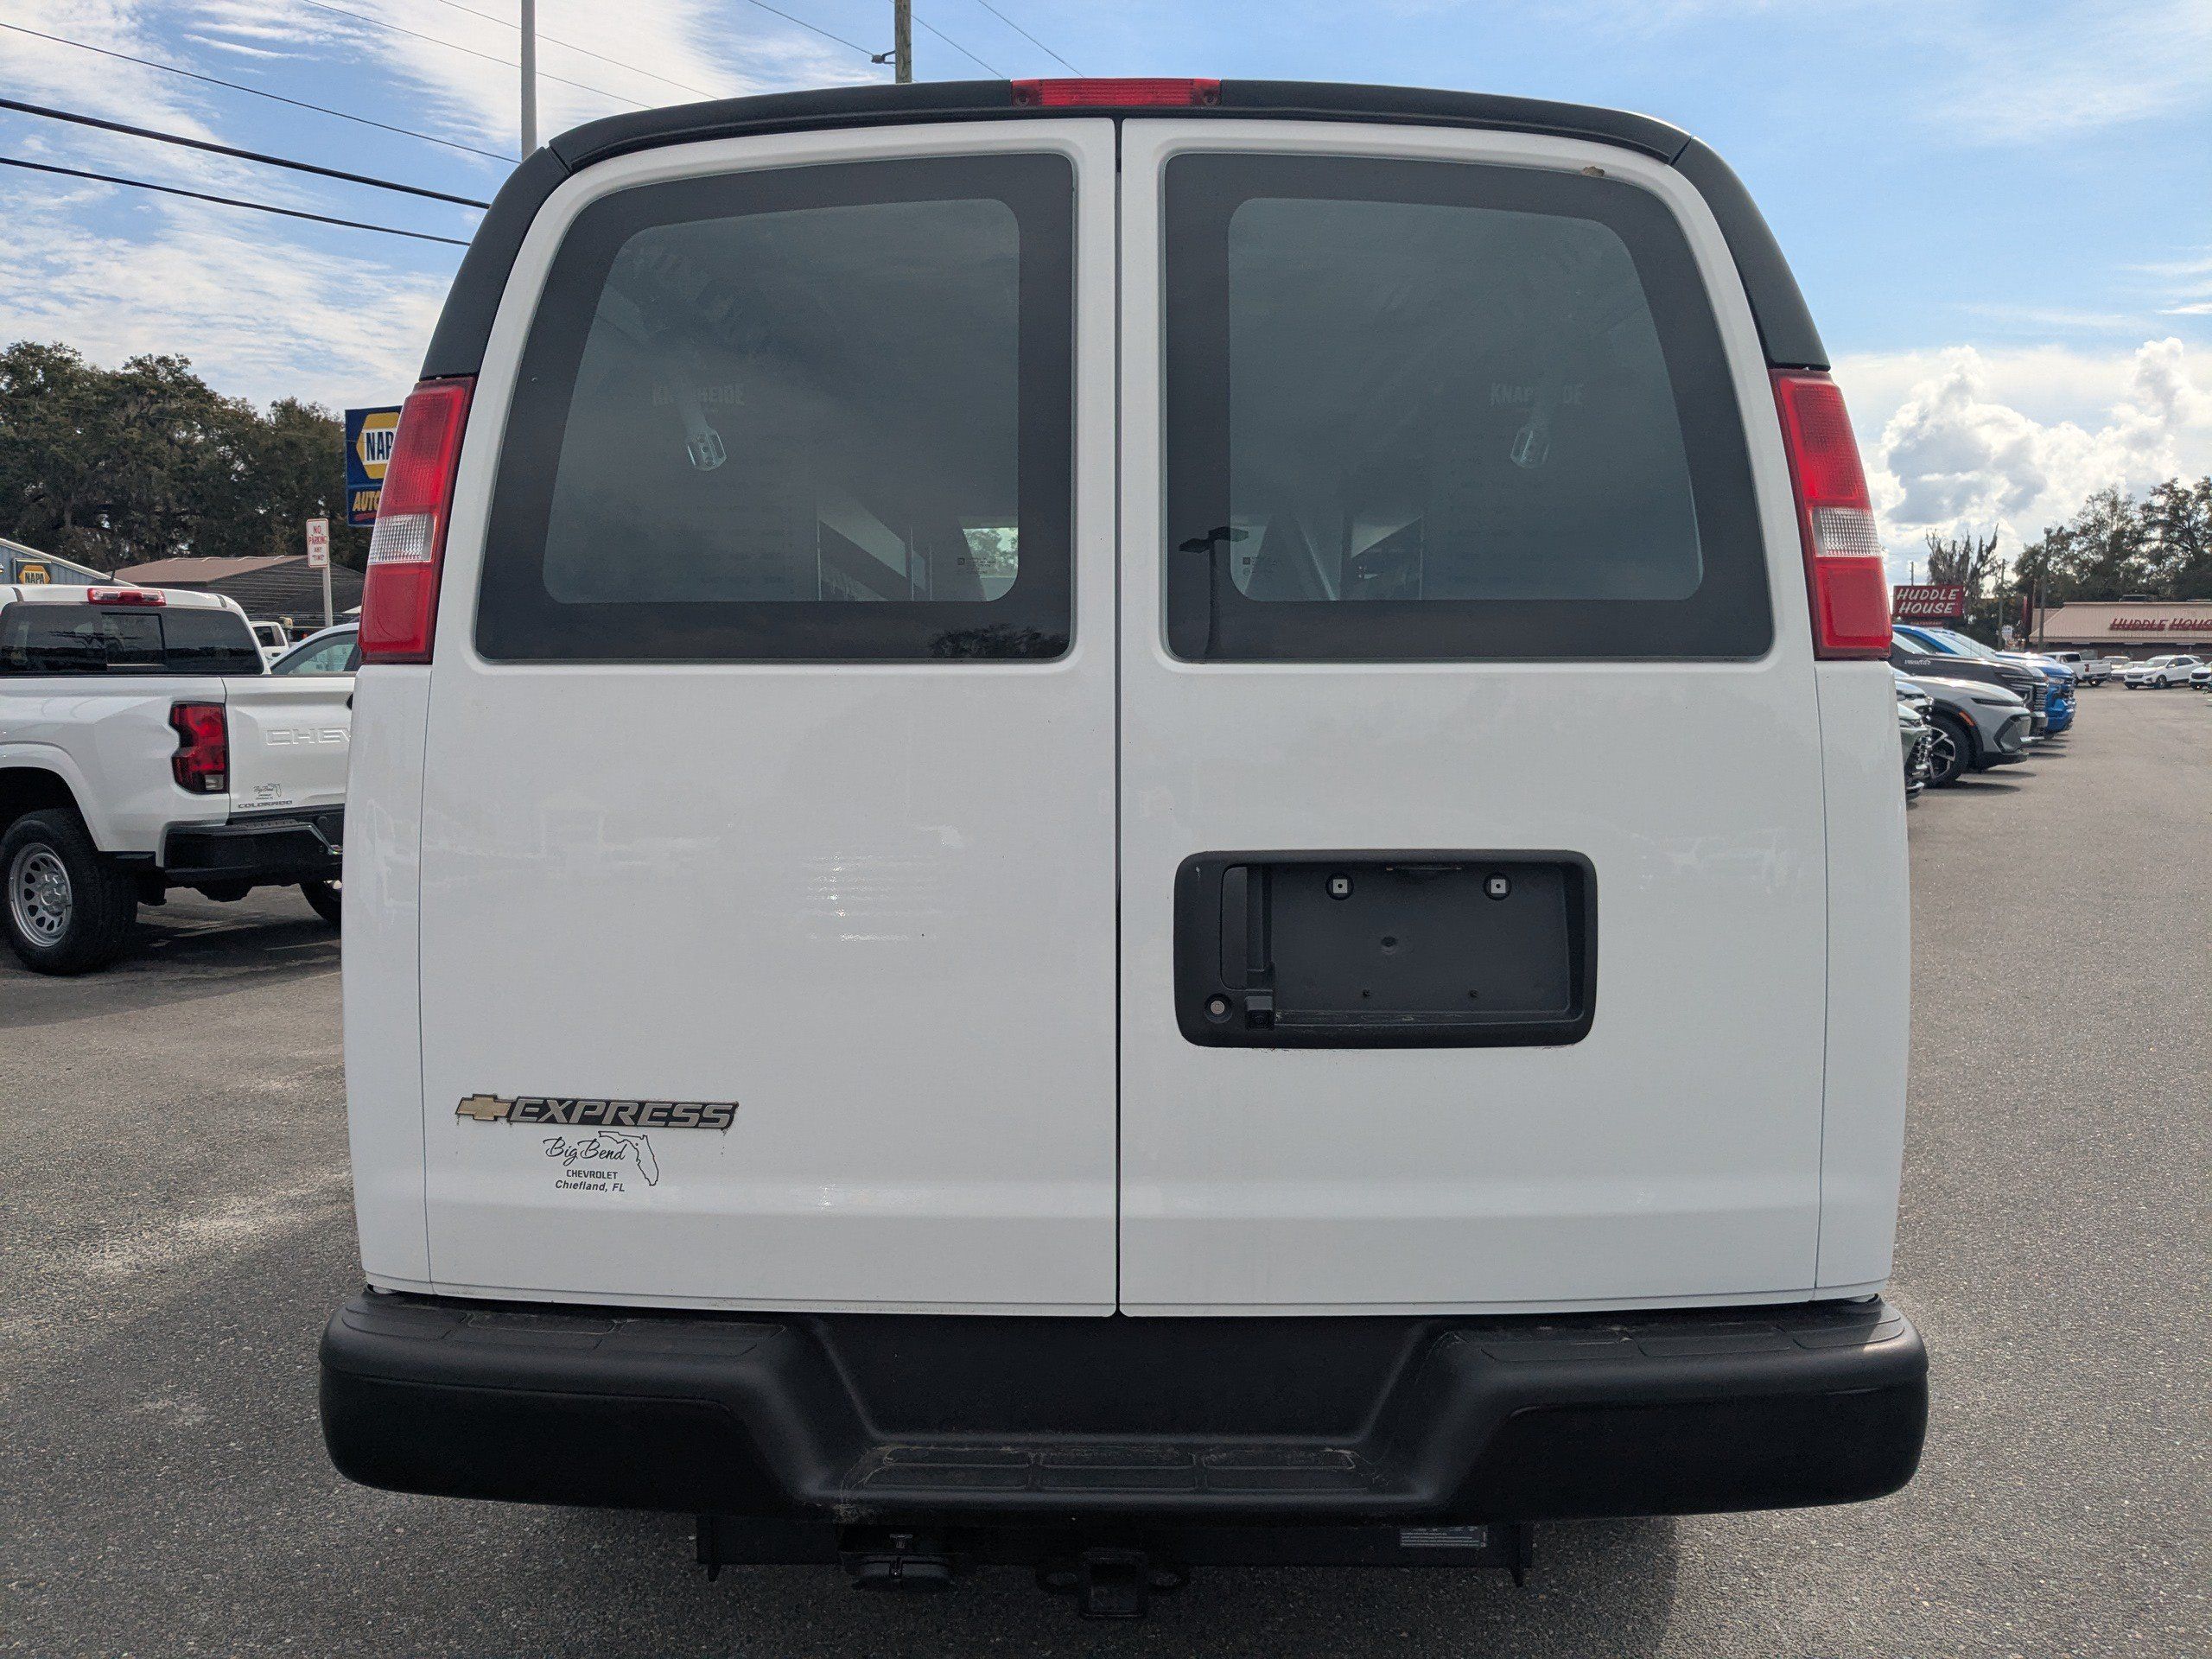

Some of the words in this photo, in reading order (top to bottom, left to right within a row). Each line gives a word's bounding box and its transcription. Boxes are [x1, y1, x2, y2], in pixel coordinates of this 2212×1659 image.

[313, 525, 321, 534] NO
[308, 536, 327, 545] PARKING
[24, 572, 44, 584] NAPA
[1896, 588, 1960, 601] HUDDLE
[1898, 601, 1955, 614] HOUSE
[2109, 618, 2170, 631] HUDDLE
[238, 800, 293, 809] COLORADO
[512, 1097, 734, 1127] EXPRESS
[543, 1136, 578, 1166] Big
[577, 1138, 628, 1160] Bend
[566, 1169, 618, 1179] CHEVROLET
[555, 1179, 608, 1192] Chiefland,
[611, 1183, 626, 1192] FL
